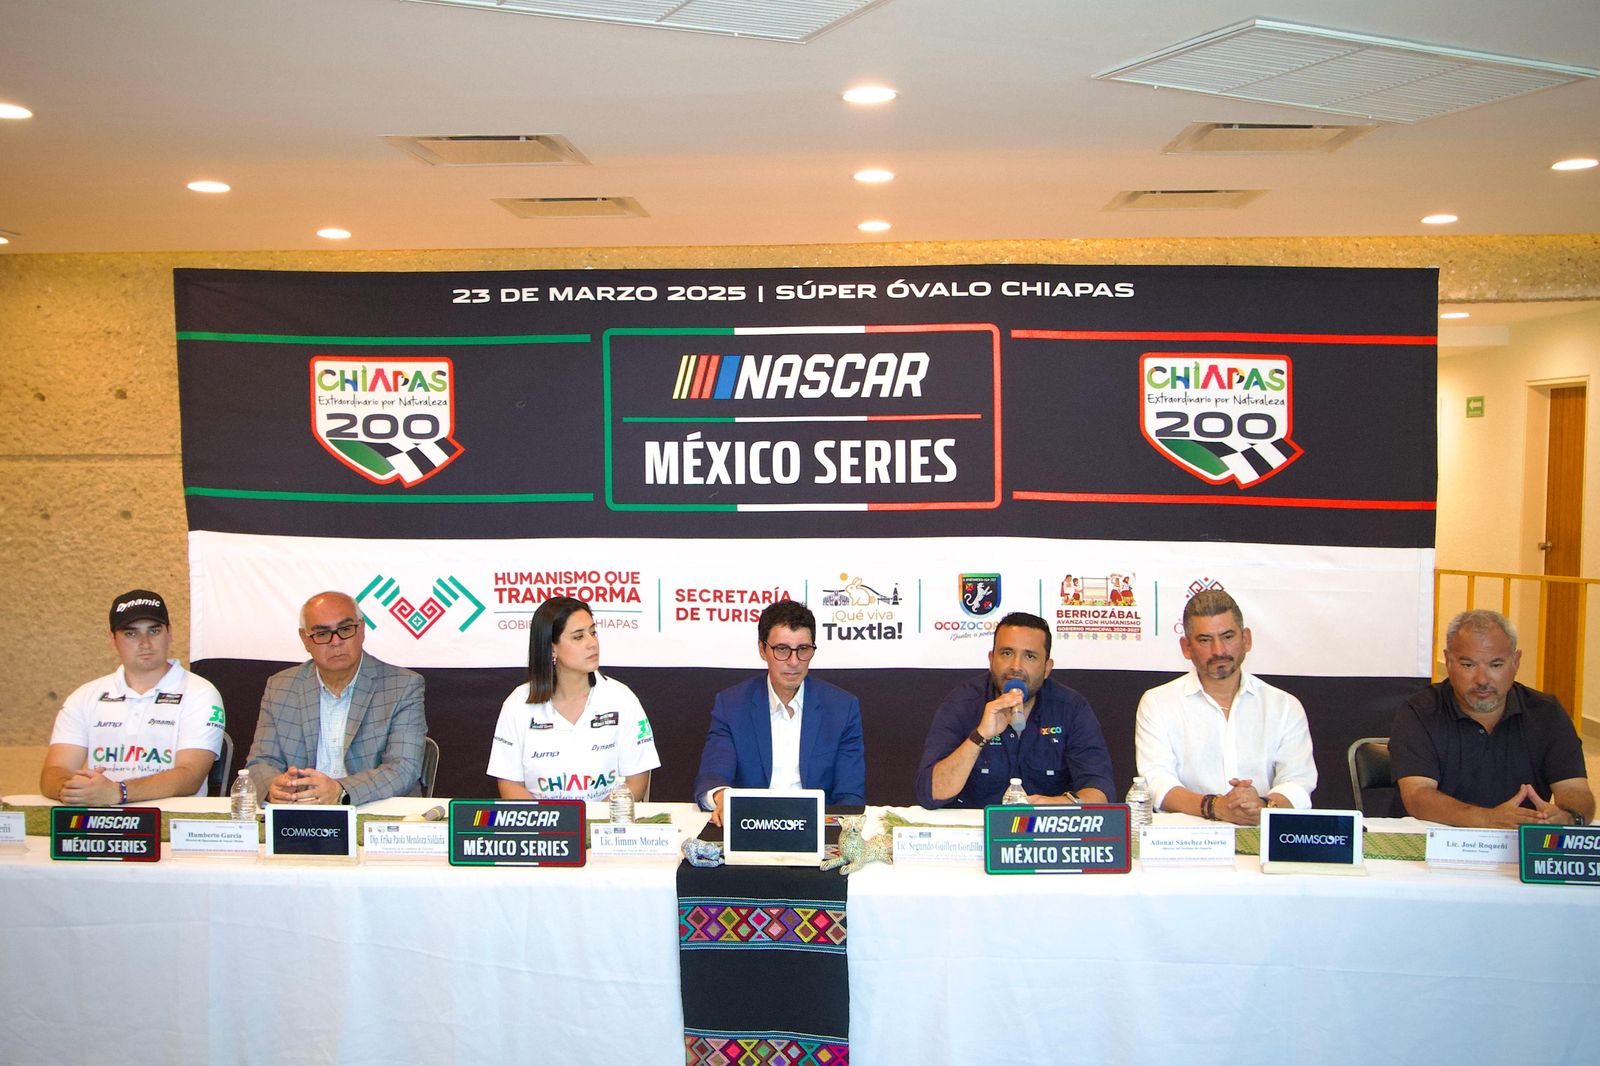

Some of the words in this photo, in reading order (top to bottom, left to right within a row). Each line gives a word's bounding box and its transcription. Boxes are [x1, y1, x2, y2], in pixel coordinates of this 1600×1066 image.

[452, 288, 491, 304] 23
[500, 287, 539, 303] DE
[548, 285, 658, 302] MARZO
[667, 285, 747, 301] 2025
[775, 280, 878, 300] SÚPER
[886, 279, 992, 299] ÓVALO
[1001, 281, 1135, 298] CHIAPAS
[317, 365, 448, 392] CHIAPAS
[733, 352, 931, 399] NASCAR
[1146, 361, 1286, 391] CHIAPAS
[318, 394, 379, 408] Extraordinario
[382, 400, 396, 410] por
[399, 396, 448, 407] Naturaleza
[1147, 392, 1212, 406] Extraordinario
[1215, 397, 1231, 408] por
[1233, 395, 1286, 406] Naturaleza
[325, 412, 440, 440] 200
[1155, 411, 1277, 440] 200
[644, 430, 801, 485] MÉXICO
[813, 438, 958, 484] SERIES
[494, 571, 601, 586] HUMANISMO
[604, 570, 641, 587] QUE
[494, 586, 642, 604] TRANSFORMA
[675, 586, 791, 604] SECRETARÍA
[116, 598, 161, 613] Dynamic
[1056, 608, 1141, 620] BERRIOZÁBAL
[675, 607, 700, 621] DE
[708, 607, 760, 623] TURIS
[831, 608, 864, 622] ¡Qué
[867, 610, 894, 620] viva
[595, 619, 639, 630] HIAPAS
[822, 622, 903, 641] Tuxtla!
[147, 718, 176, 726] Dynamic
[93, 744, 173, 764] CHIAPAS
[530, 751, 560, 759] Jump
[537, 769, 616, 792] CHIAPAS
[86, 815, 141, 830] NASCAR
[494, 810, 561, 828] NASCAR
[740, 818, 805, 831] COMMSCOPE
[1033, 815, 1105, 833] NASCAR
[188, 831, 220, 839] Humberto
[221, 832, 242, 840] García
[280, 827, 339, 838] COMMSCOPE
[1279, 833, 1346, 846] COMMSCOPE
[62, 837, 106, 854] MÉXICO
[107, 839, 147, 855] SERIES
[463, 837, 517, 857] MÉXICO
[520, 840, 570, 857] SERIES
[615, 836, 637, 848] Jimmy
[639, 836, 669, 847] Morales
[1446, 841, 1460, 849] Lic.
[1461, 841, 1477, 849] José
[1562, 835, 1600, 850] NASC
[1000, 844, 1058, 864] MÉXICO
[1061, 846, 1114, 864] SERIES
[1534, 857, 1585, 876] MÉXICO
